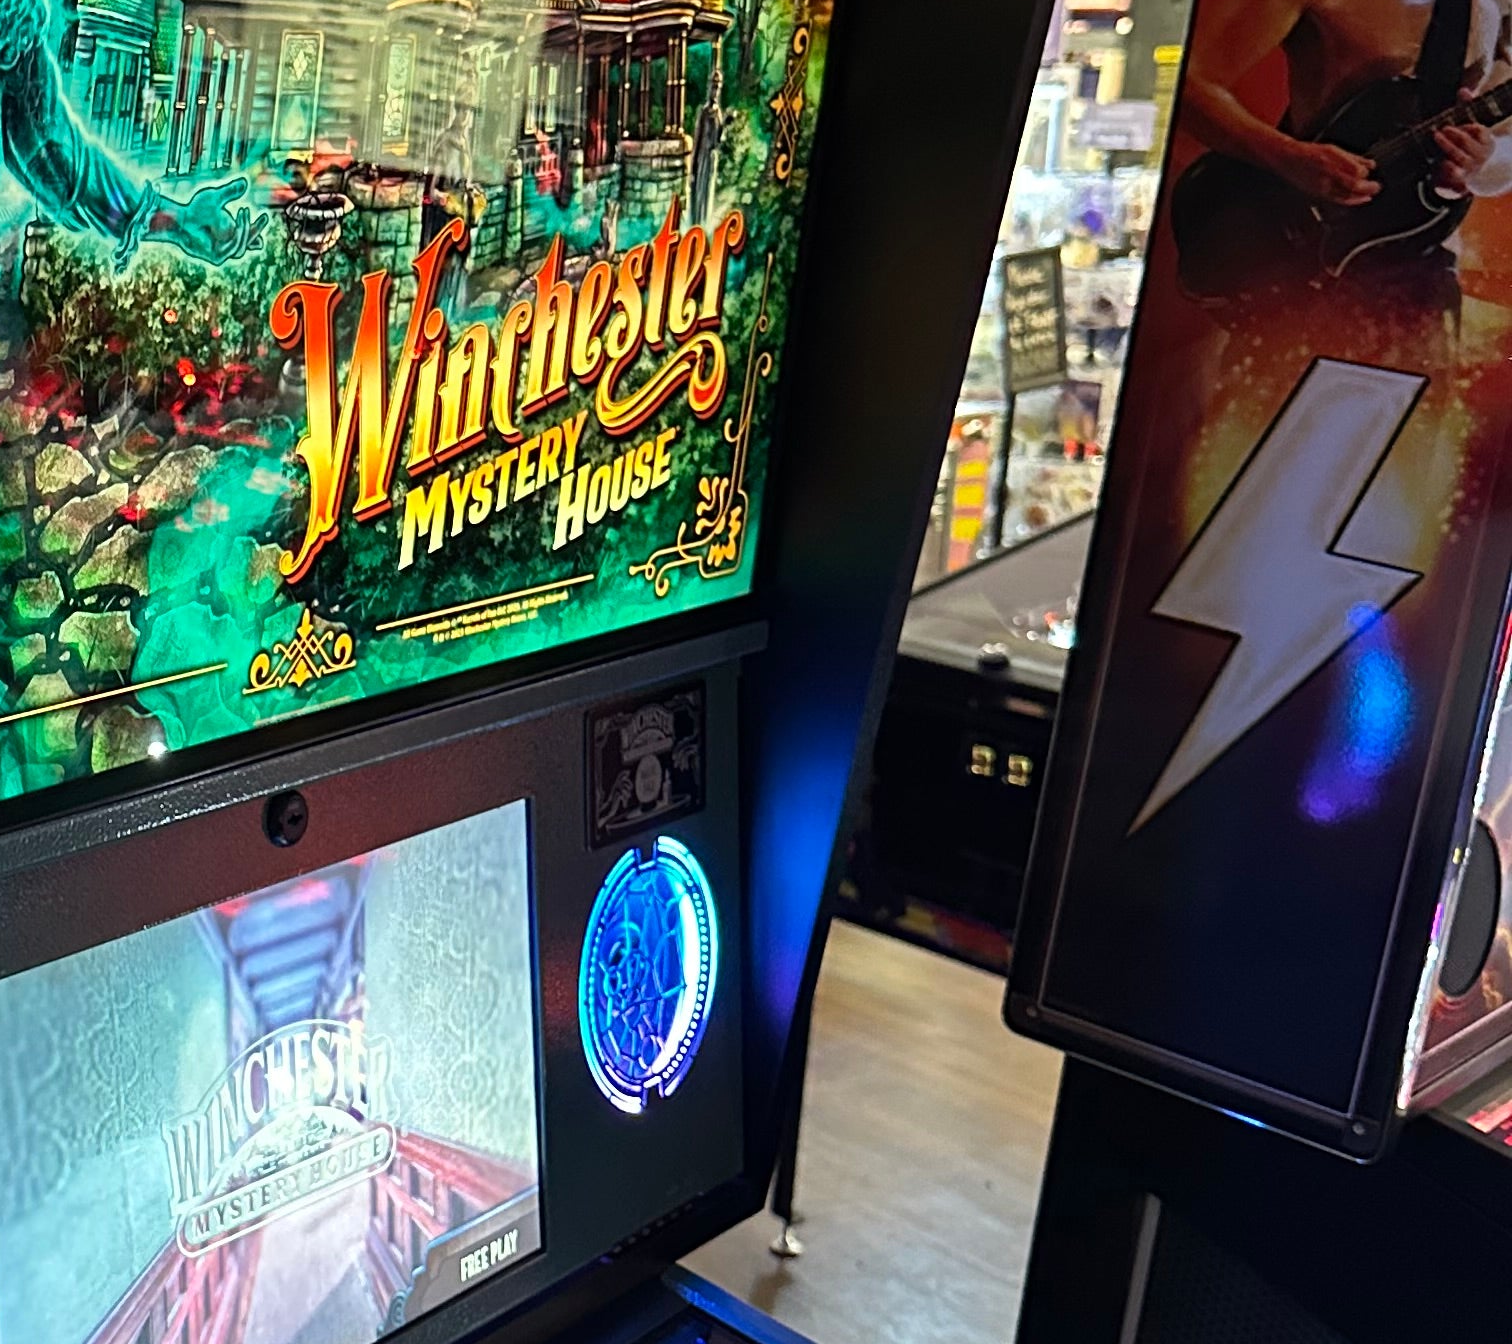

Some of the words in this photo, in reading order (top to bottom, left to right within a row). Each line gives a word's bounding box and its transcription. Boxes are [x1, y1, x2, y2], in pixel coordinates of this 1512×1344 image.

[270, 194, 746, 584] Winchester
[166, 1022, 396, 1204] WINCHESTER
[192, 1172, 300, 1239] MYSTERY
[310, 1132, 383, 1184] HOUSE
[460, 1245, 489, 1283] FREE
[490, 1228, 519, 1266] PLAY
